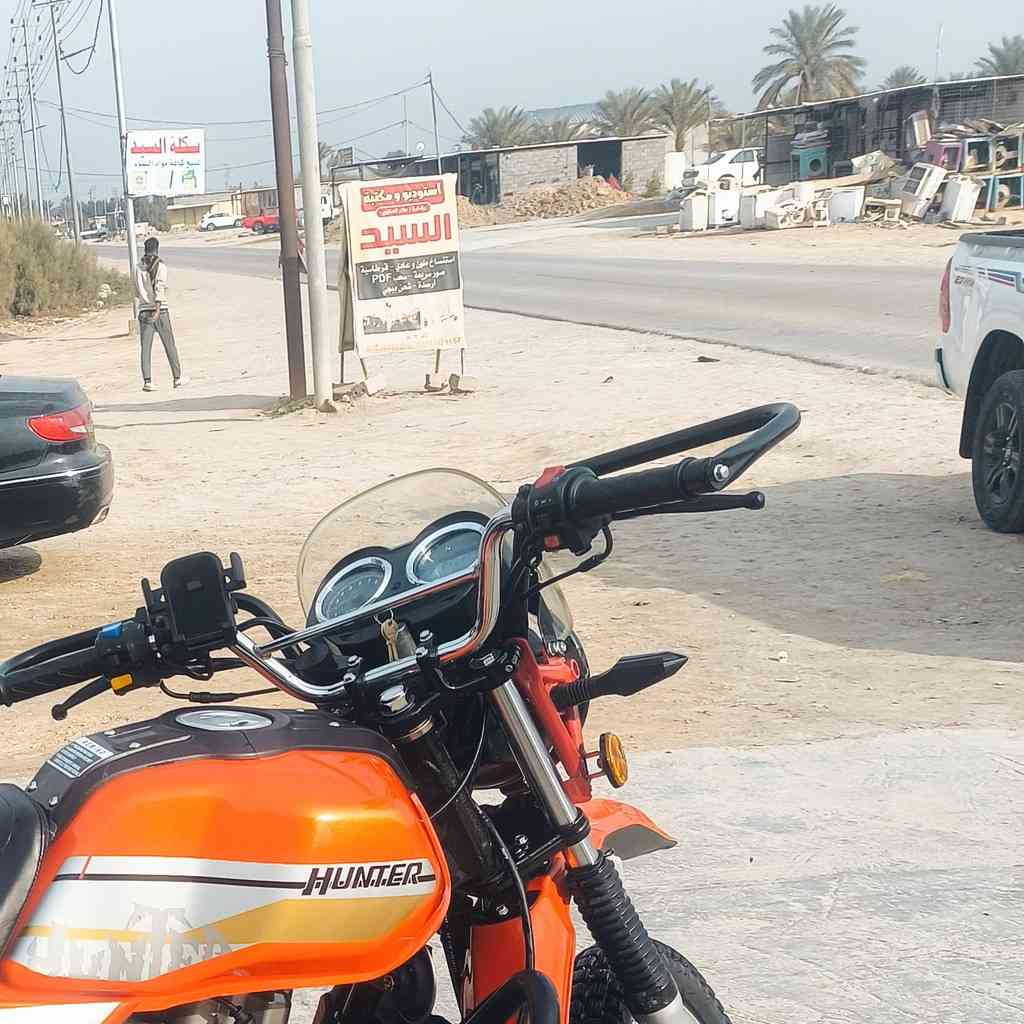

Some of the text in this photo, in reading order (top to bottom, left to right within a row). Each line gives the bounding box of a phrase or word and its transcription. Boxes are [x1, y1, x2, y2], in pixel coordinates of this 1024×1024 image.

[362, 190, 393, 206] مكتبة
[360, 213, 452, 255] السيد
[371, 272, 392, 284] PDF
[301, 861, 423, 896] HUNTER
